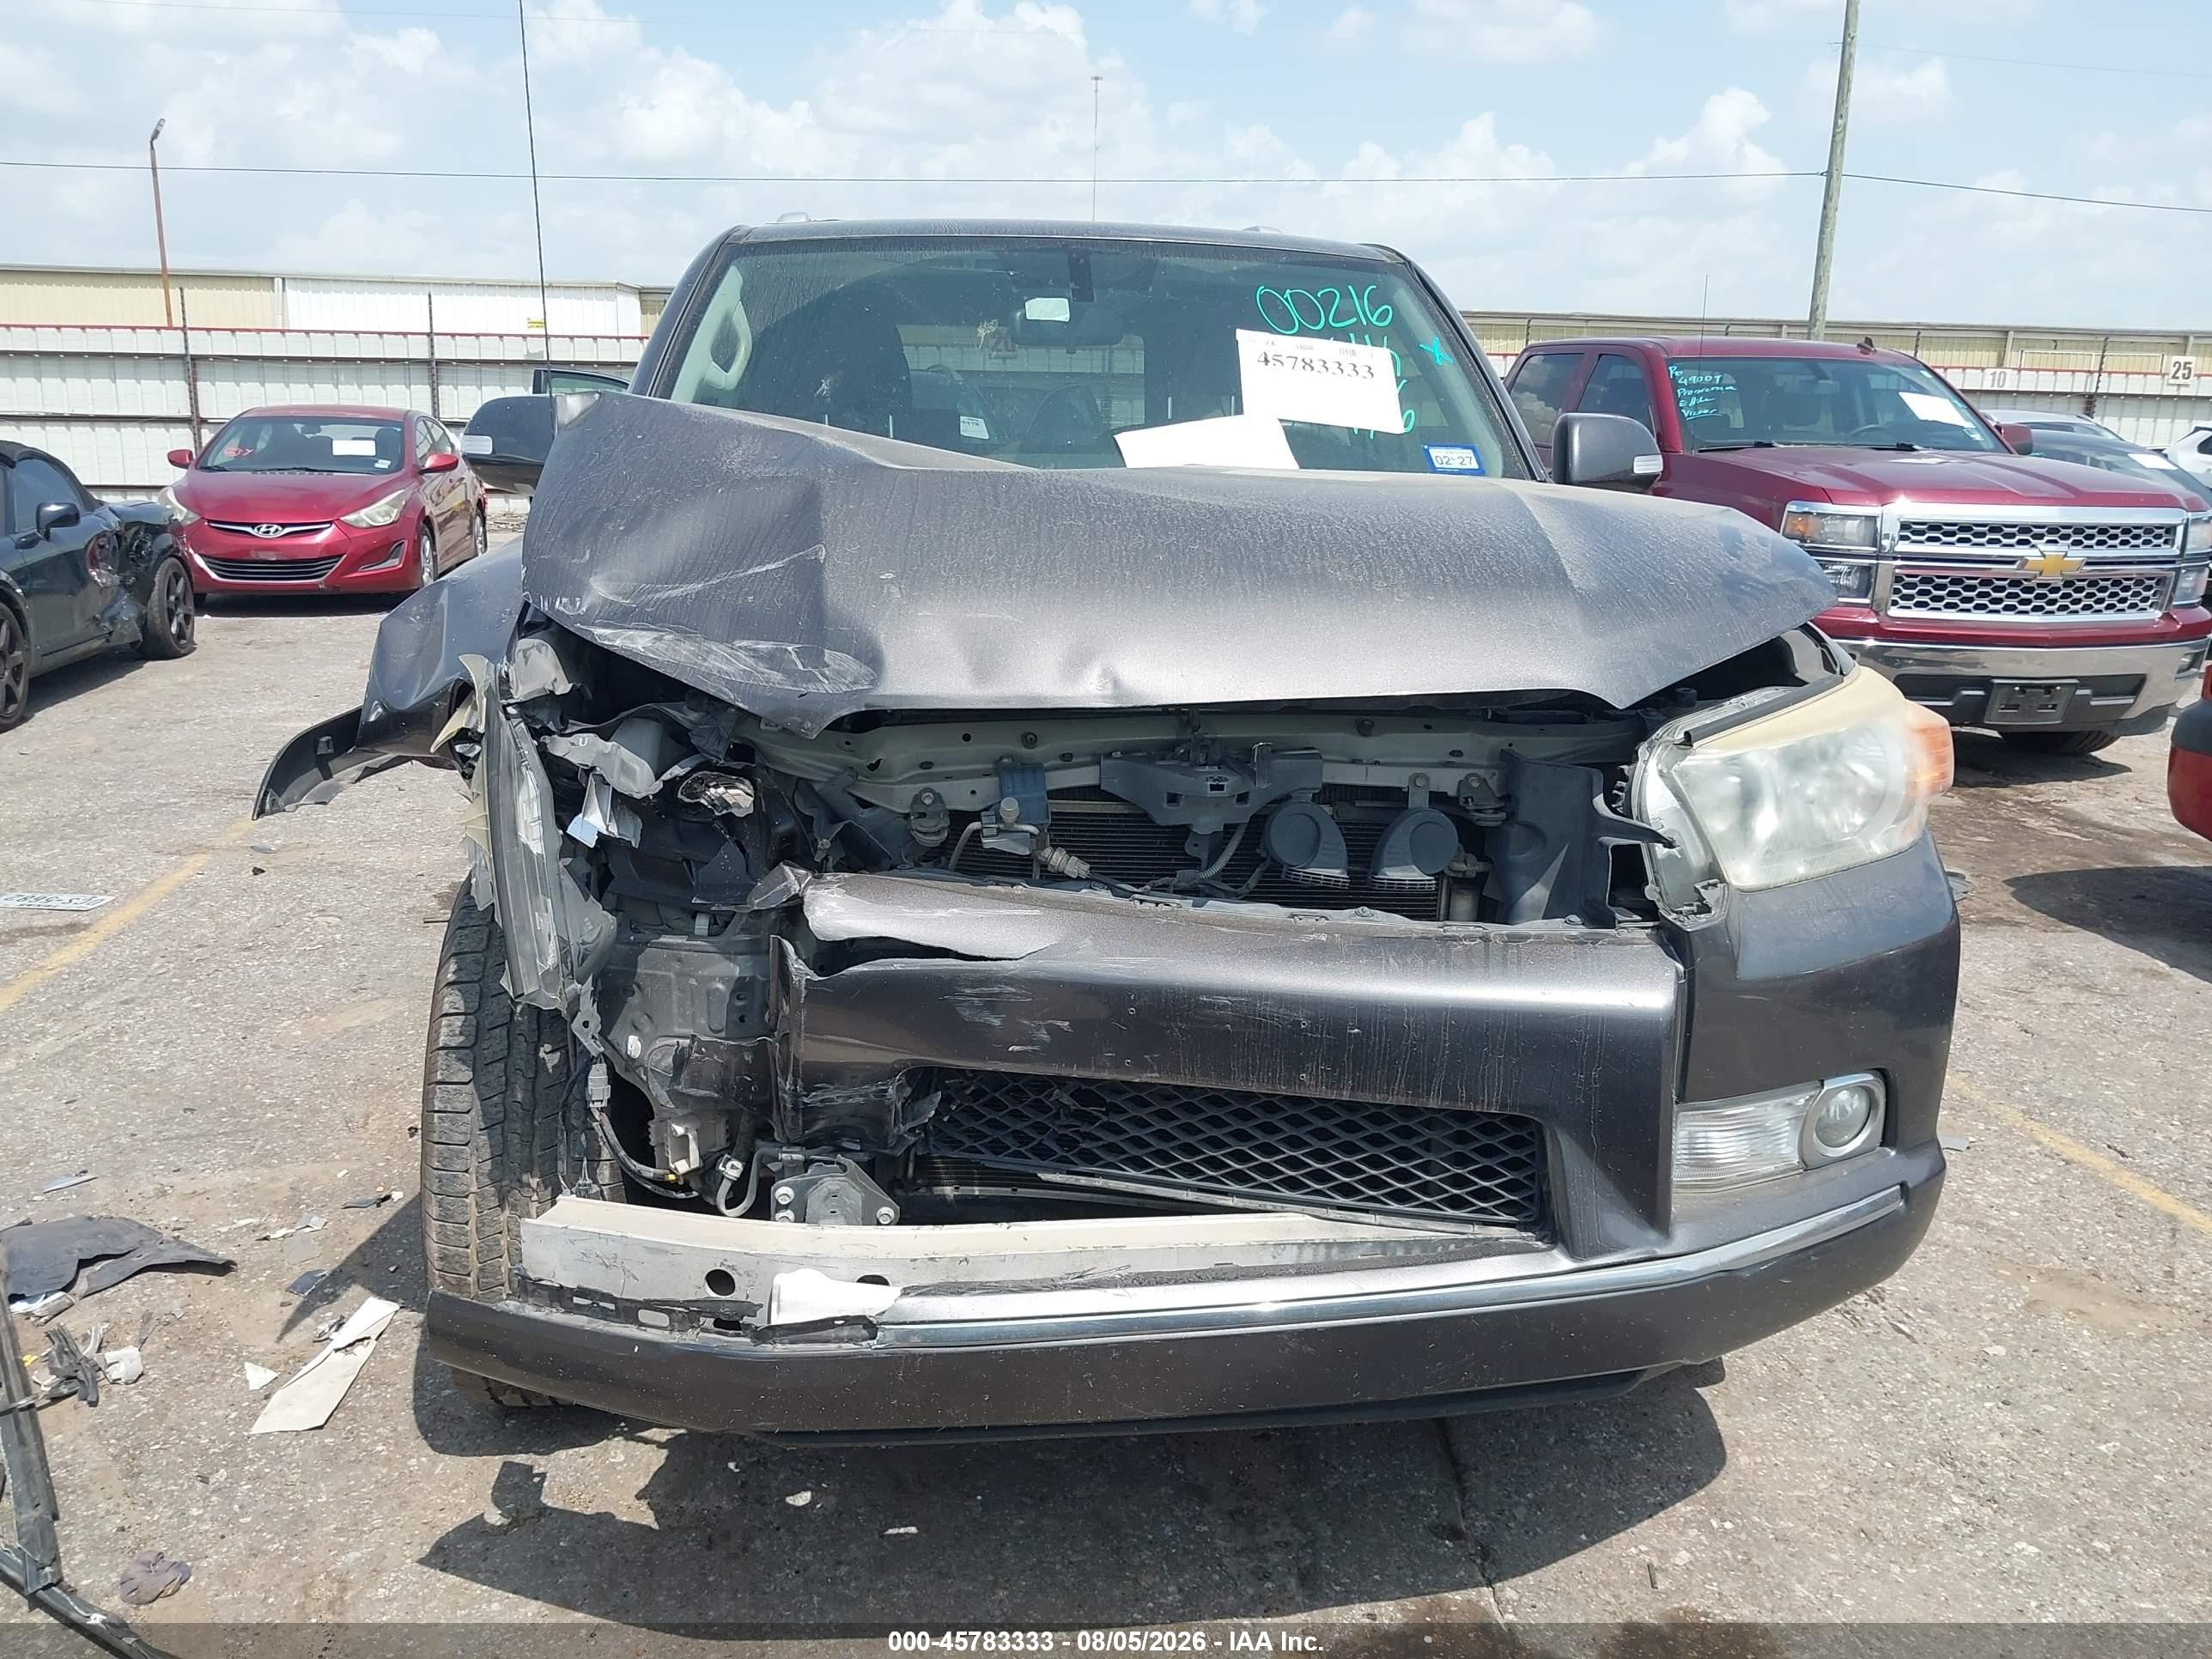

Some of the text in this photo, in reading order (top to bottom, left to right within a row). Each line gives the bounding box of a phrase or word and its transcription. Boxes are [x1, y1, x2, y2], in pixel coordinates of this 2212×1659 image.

[1256, 285, 1394, 335] 00216
[1256, 350, 1375, 380] 45783333
[2171, 361, 2193, 380] 25
[1989, 370, 2007, 389] 10
